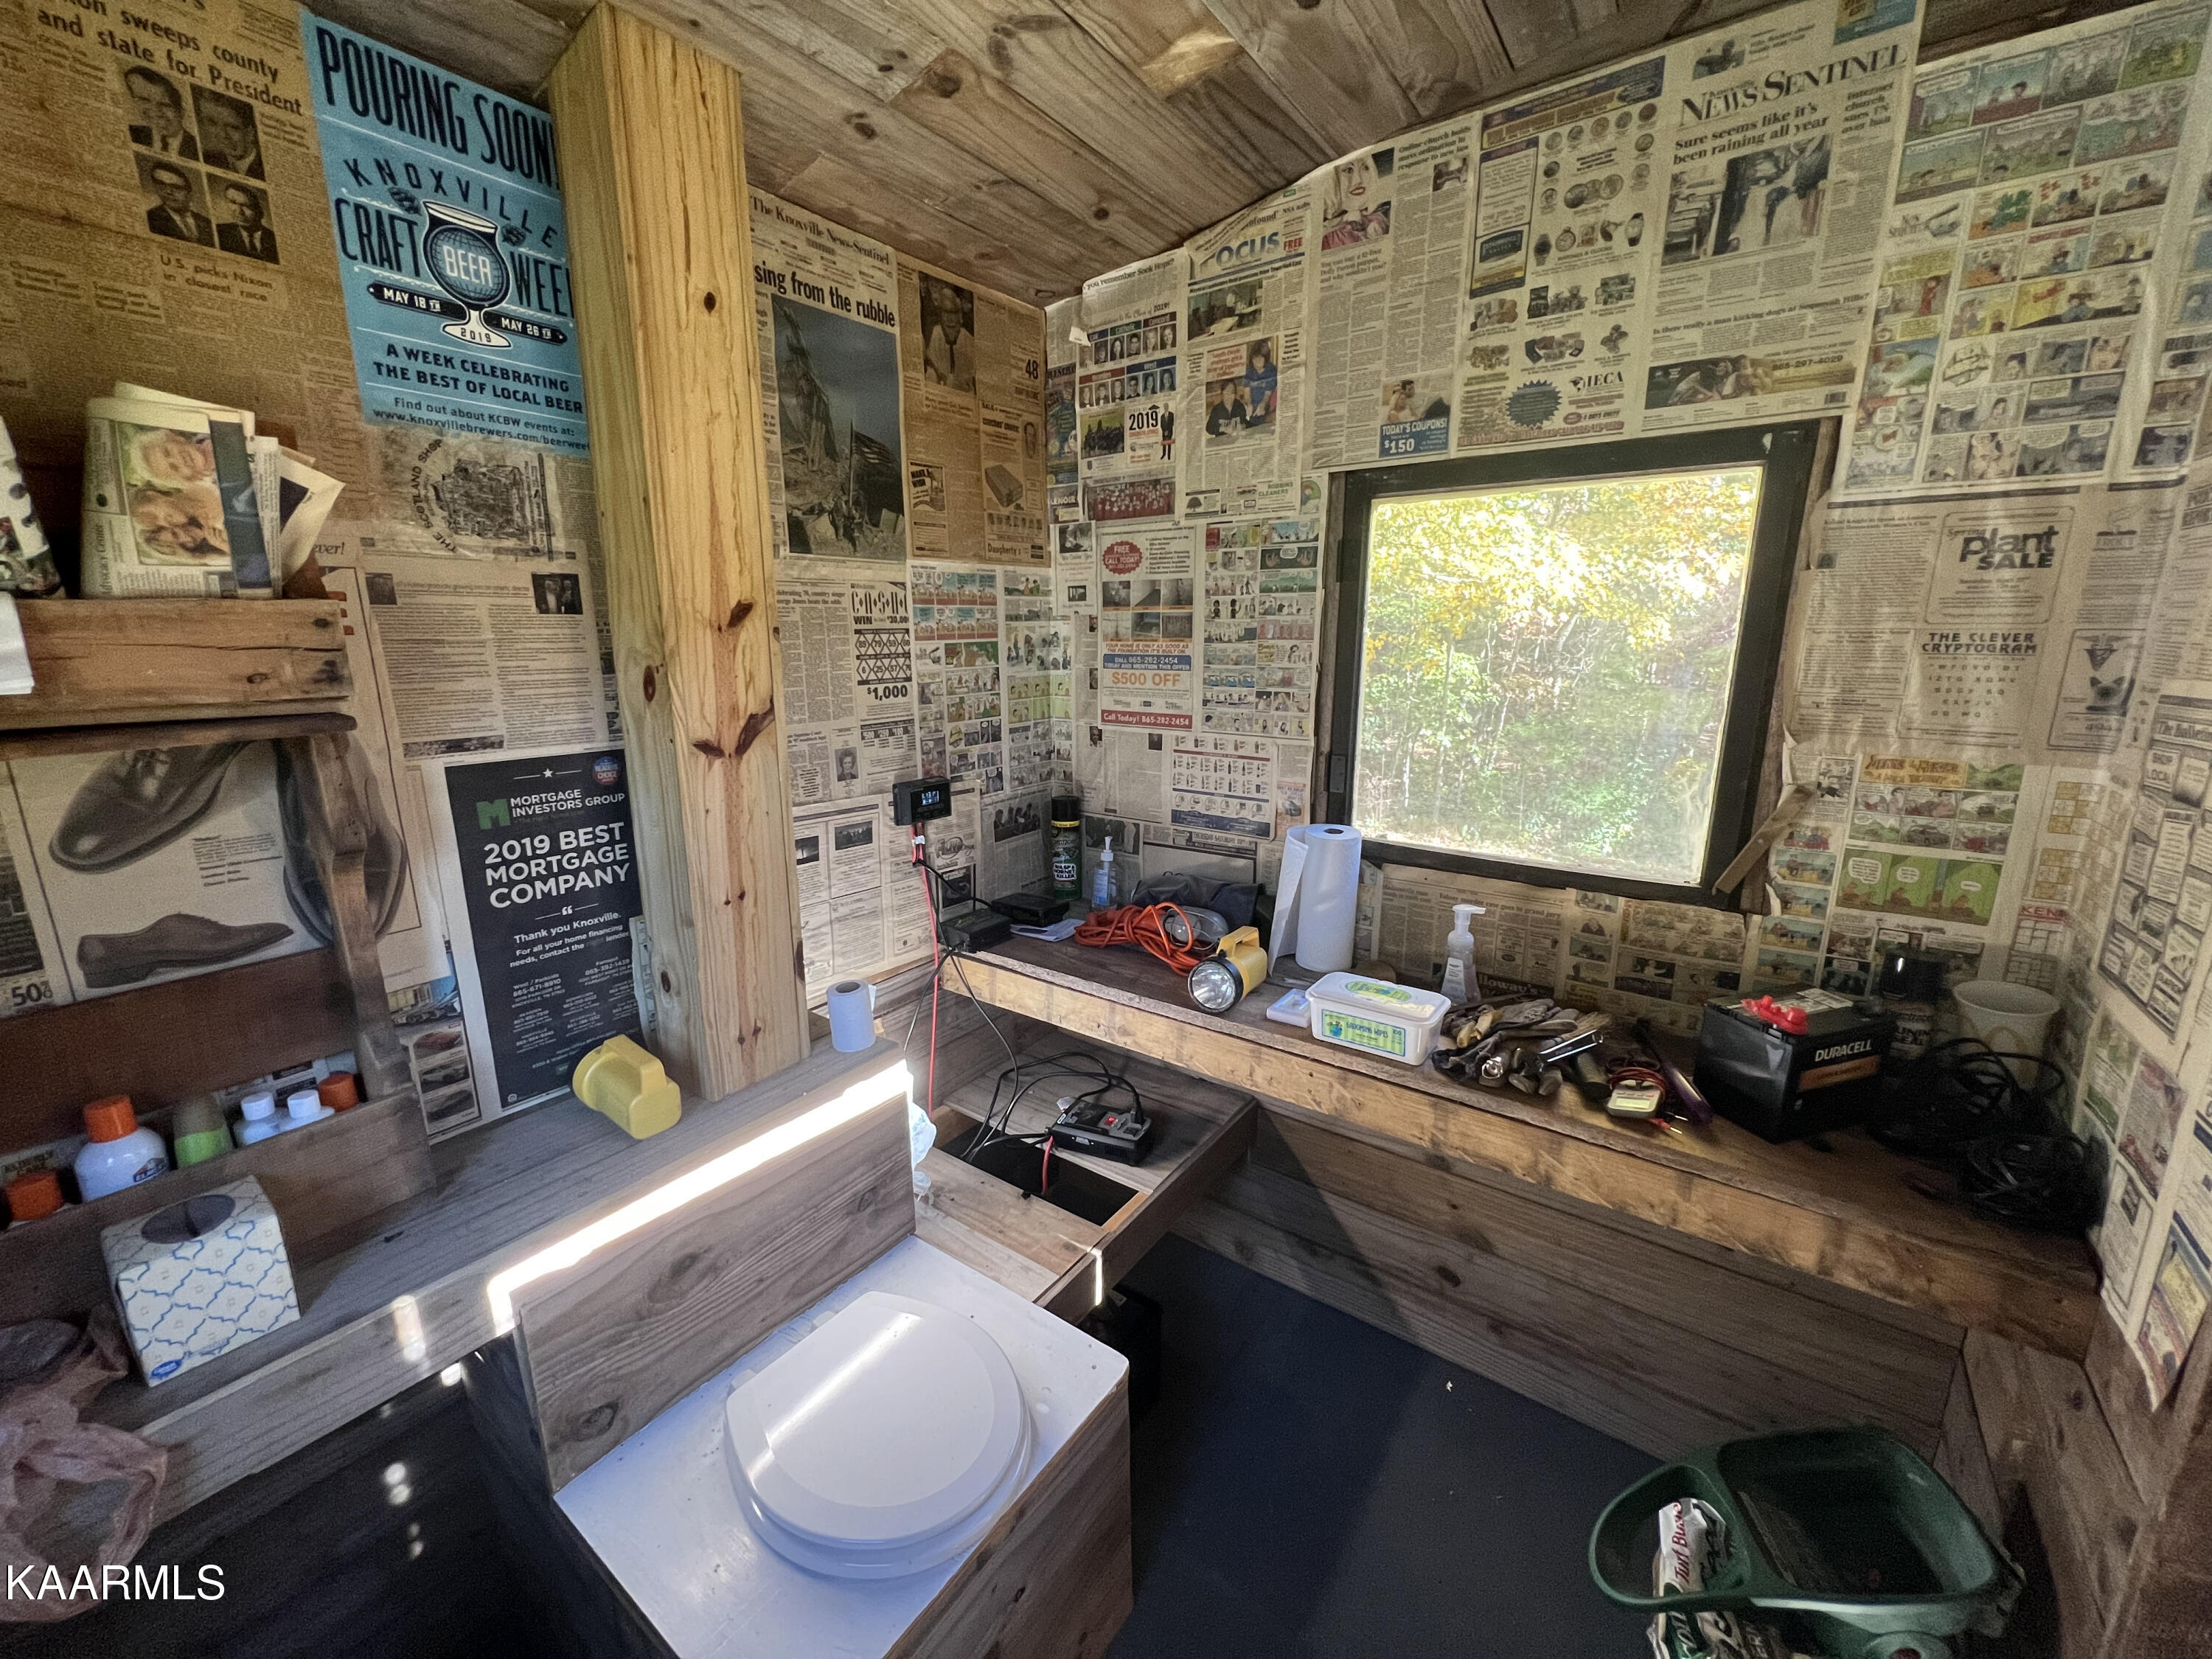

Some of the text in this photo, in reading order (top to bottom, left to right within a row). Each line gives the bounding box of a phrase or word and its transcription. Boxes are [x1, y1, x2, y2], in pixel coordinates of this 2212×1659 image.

[121, 6, 279, 83] sweeps county
[38, 8, 83, 38] and
[97, 29, 155, 64] state
[167, 49, 196, 78] for
[209, 63, 302, 117] President
[316, 25, 469, 156] POURING
[1678, 44, 1907, 129] NEWS SENTINEL
[1847, 82, 1893, 101] Internet
[1845, 94, 1885, 111] church
[1674, 102, 1818, 150] Sure seems like it's
[1844, 111, 1870, 122] sues
[1425, 126, 1471, 147] church holds
[1842, 122, 1865, 133] over
[1418, 140, 1457, 157] ordination
[1673, 116, 1830, 166] been raining all year
[1440, 149, 1455, 158] new
[344, 158, 558, 248] KNOXVILLE
[750, 195, 889, 265] The Knoxville News-Sentinel
[335, 198, 421, 277] CRAFT
[442, 245, 493, 287] BEER
[1283, 237, 1303, 251] FREE
[194, 265, 228, 279] picks
[1087, 281, 1099, 291] you
[1101, 271, 1136, 286] remember
[1137, 265, 1153, 276] Sock
[164, 271, 267, 301] in closest race
[383, 286, 409, 305] MAY
[754, 260, 896, 327] sing from the rubble
[501, 317, 523, 332] MAY
[1661, 324, 1682, 333] there
[1683, 320, 1705, 330] really
[1714, 316, 1732, 325] man
[1733, 311, 1764, 323] kicking
[1765, 307, 1786, 318] dogs
[1799, 297, 1840, 312] Sequoyah
[461, 327, 492, 343] 2019
[386, 344, 569, 392] A WEEK CELEBRATING
[1026, 358, 1038, 379] 48
[372, 361, 583, 414] THE BEST OF LOCAL BEER
[1587, 371, 1624, 387] IECA
[394, 397, 575, 437] Find out about KCBW events at:
[1129, 410, 1158, 431] 2019
[1382, 417, 1447, 436] TODAY'S COUPONS!
[1384, 438, 1415, 453] $150
[411, 439, 457, 553] THE SCOTLAND SHOP
[1113, 545, 1130, 553] FREE
[1959, 525, 2059, 563] plant
[1105, 556, 1119, 564] CALL
[1976, 553, 2054, 571] SALE
[854, 616, 872, 625] WIN
[1921, 643, 2037, 653] CRYPTOGRAM
[1928, 633, 2034, 644] THE CLEVER
[876, 666, 883, 674] 25
[1112, 672, 1180, 686] $500 OFF
[867, 684, 908, 701] $1,000
[1117, 714, 1139, 722] Today!
[1141, 716, 1189, 726] 865-282-2454
[510, 789, 582, 807] MORTGAGE
[512, 793, 625, 818] INVESTORS GROUP
[484, 821, 625, 864] 2019 BEST
[485, 843, 630, 886] MORTGAGE
[490, 863, 630, 908] COMPANY
[1460, 897, 1485, 905] murder
[1500, 902, 1516, 912] goes
[1524, 907, 1545, 917] grand
[1545, 911, 1560, 919] jury
[513, 912, 622, 944] Thank you Knoxville.
[509, 956, 538, 967] needs,
[540, 946, 570, 959] contact
[606, 931, 630, 942] lender
[516, 948, 531, 956] For
[544, 939, 563, 951] your
[564, 933, 587, 944] home
[588, 925, 623, 939] financing
[1346, 1020, 1388, 1038] GROOMING WIPES
[1815, 1039, 1872, 1062] DURACELL
[1672, 1548, 1691, 1584] Turf
